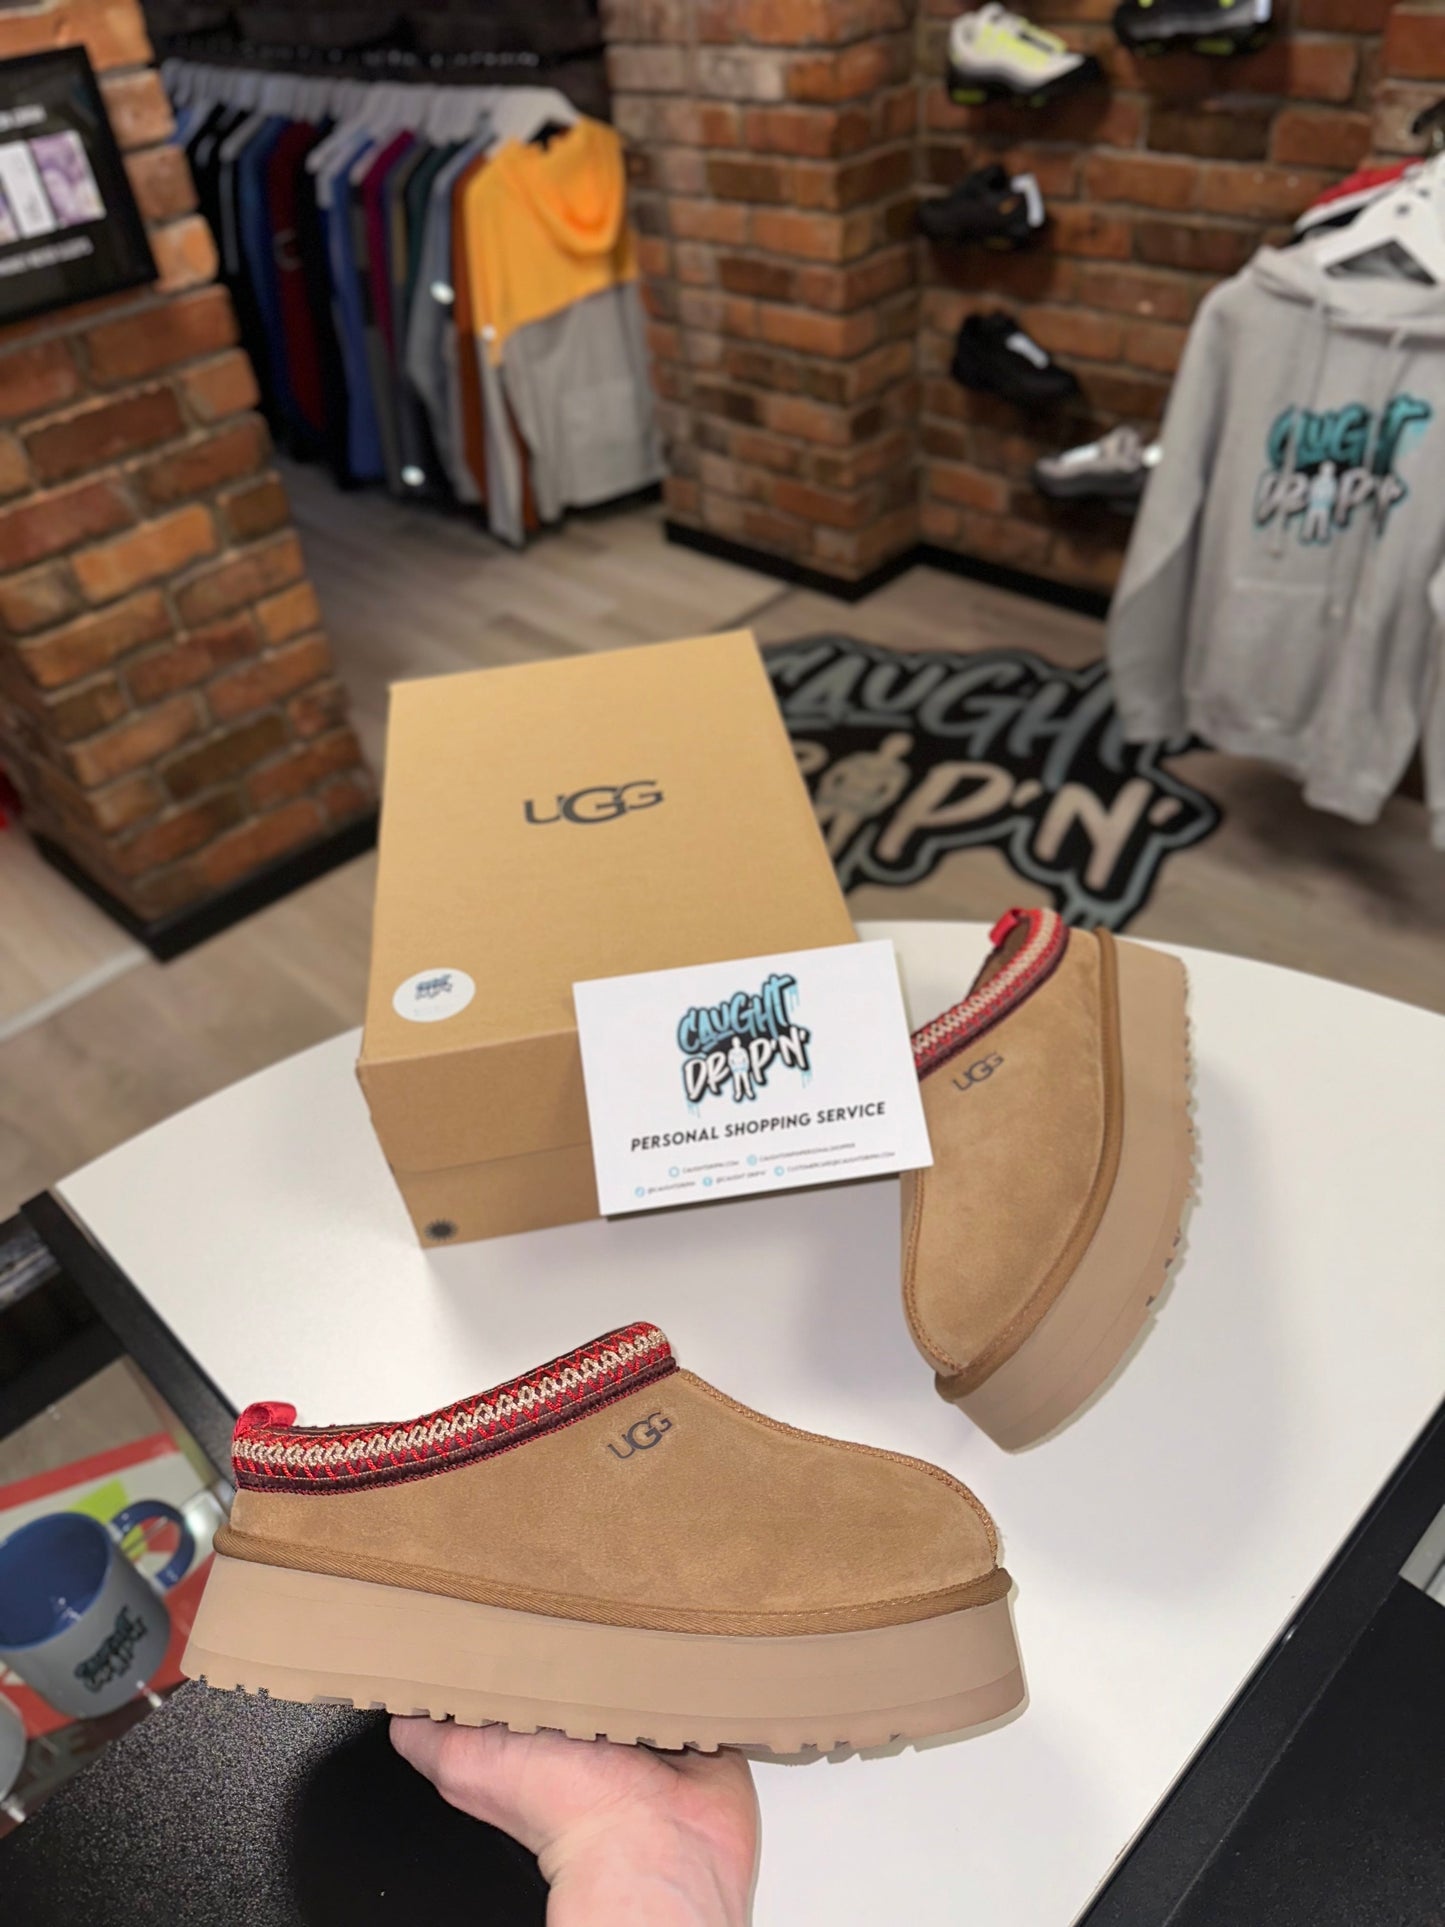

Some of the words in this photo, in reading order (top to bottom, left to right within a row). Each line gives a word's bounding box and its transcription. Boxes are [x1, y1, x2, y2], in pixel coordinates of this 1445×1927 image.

[524, 780, 664, 825] UGG
[678, 974, 796, 1055] CAUGHT
[952, 1051, 1004, 1091] UGG
[631, 1127, 719, 1152] PERSONAL
[725, 1113, 811, 1137] SHOPPING
[817, 1102, 886, 1123] SERVICE
[607, 1412, 672, 1459] UGG
